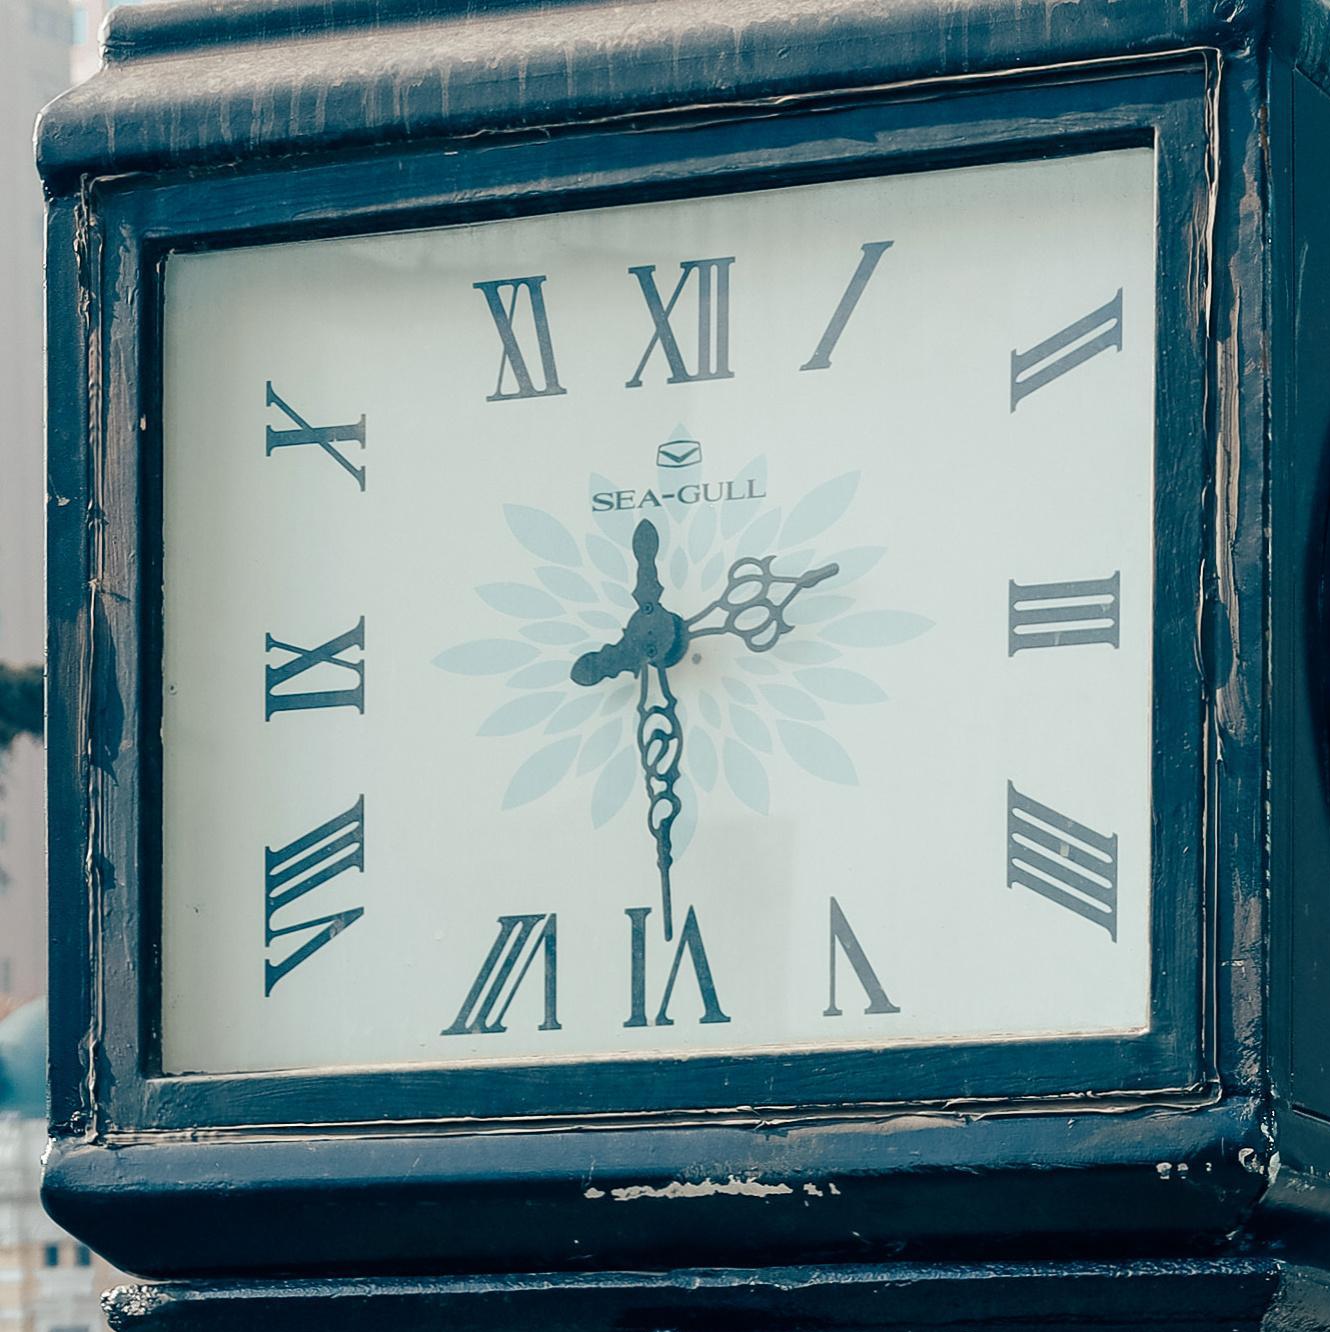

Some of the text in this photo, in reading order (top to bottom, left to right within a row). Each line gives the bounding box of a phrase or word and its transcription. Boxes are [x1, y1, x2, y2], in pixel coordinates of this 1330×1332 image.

[473, 275, 567, 402] XI
[625, 256, 736, 388] XII
[800, 240, 895, 371] I
[1010, 287, 1123, 413] II
[265, 380, 366, 492] X
[591, 479, 767, 512] SEA-GULL
[265, 614, 365, 722] IX
[1008, 570, 1121, 658] III
[265, 793, 365, 998] VIII
[1007, 779, 1118, 943] IIII
[441, 912, 562, 1036] VII
[623, 904, 731, 1028] VI
[822, 896, 901, 1016] V
